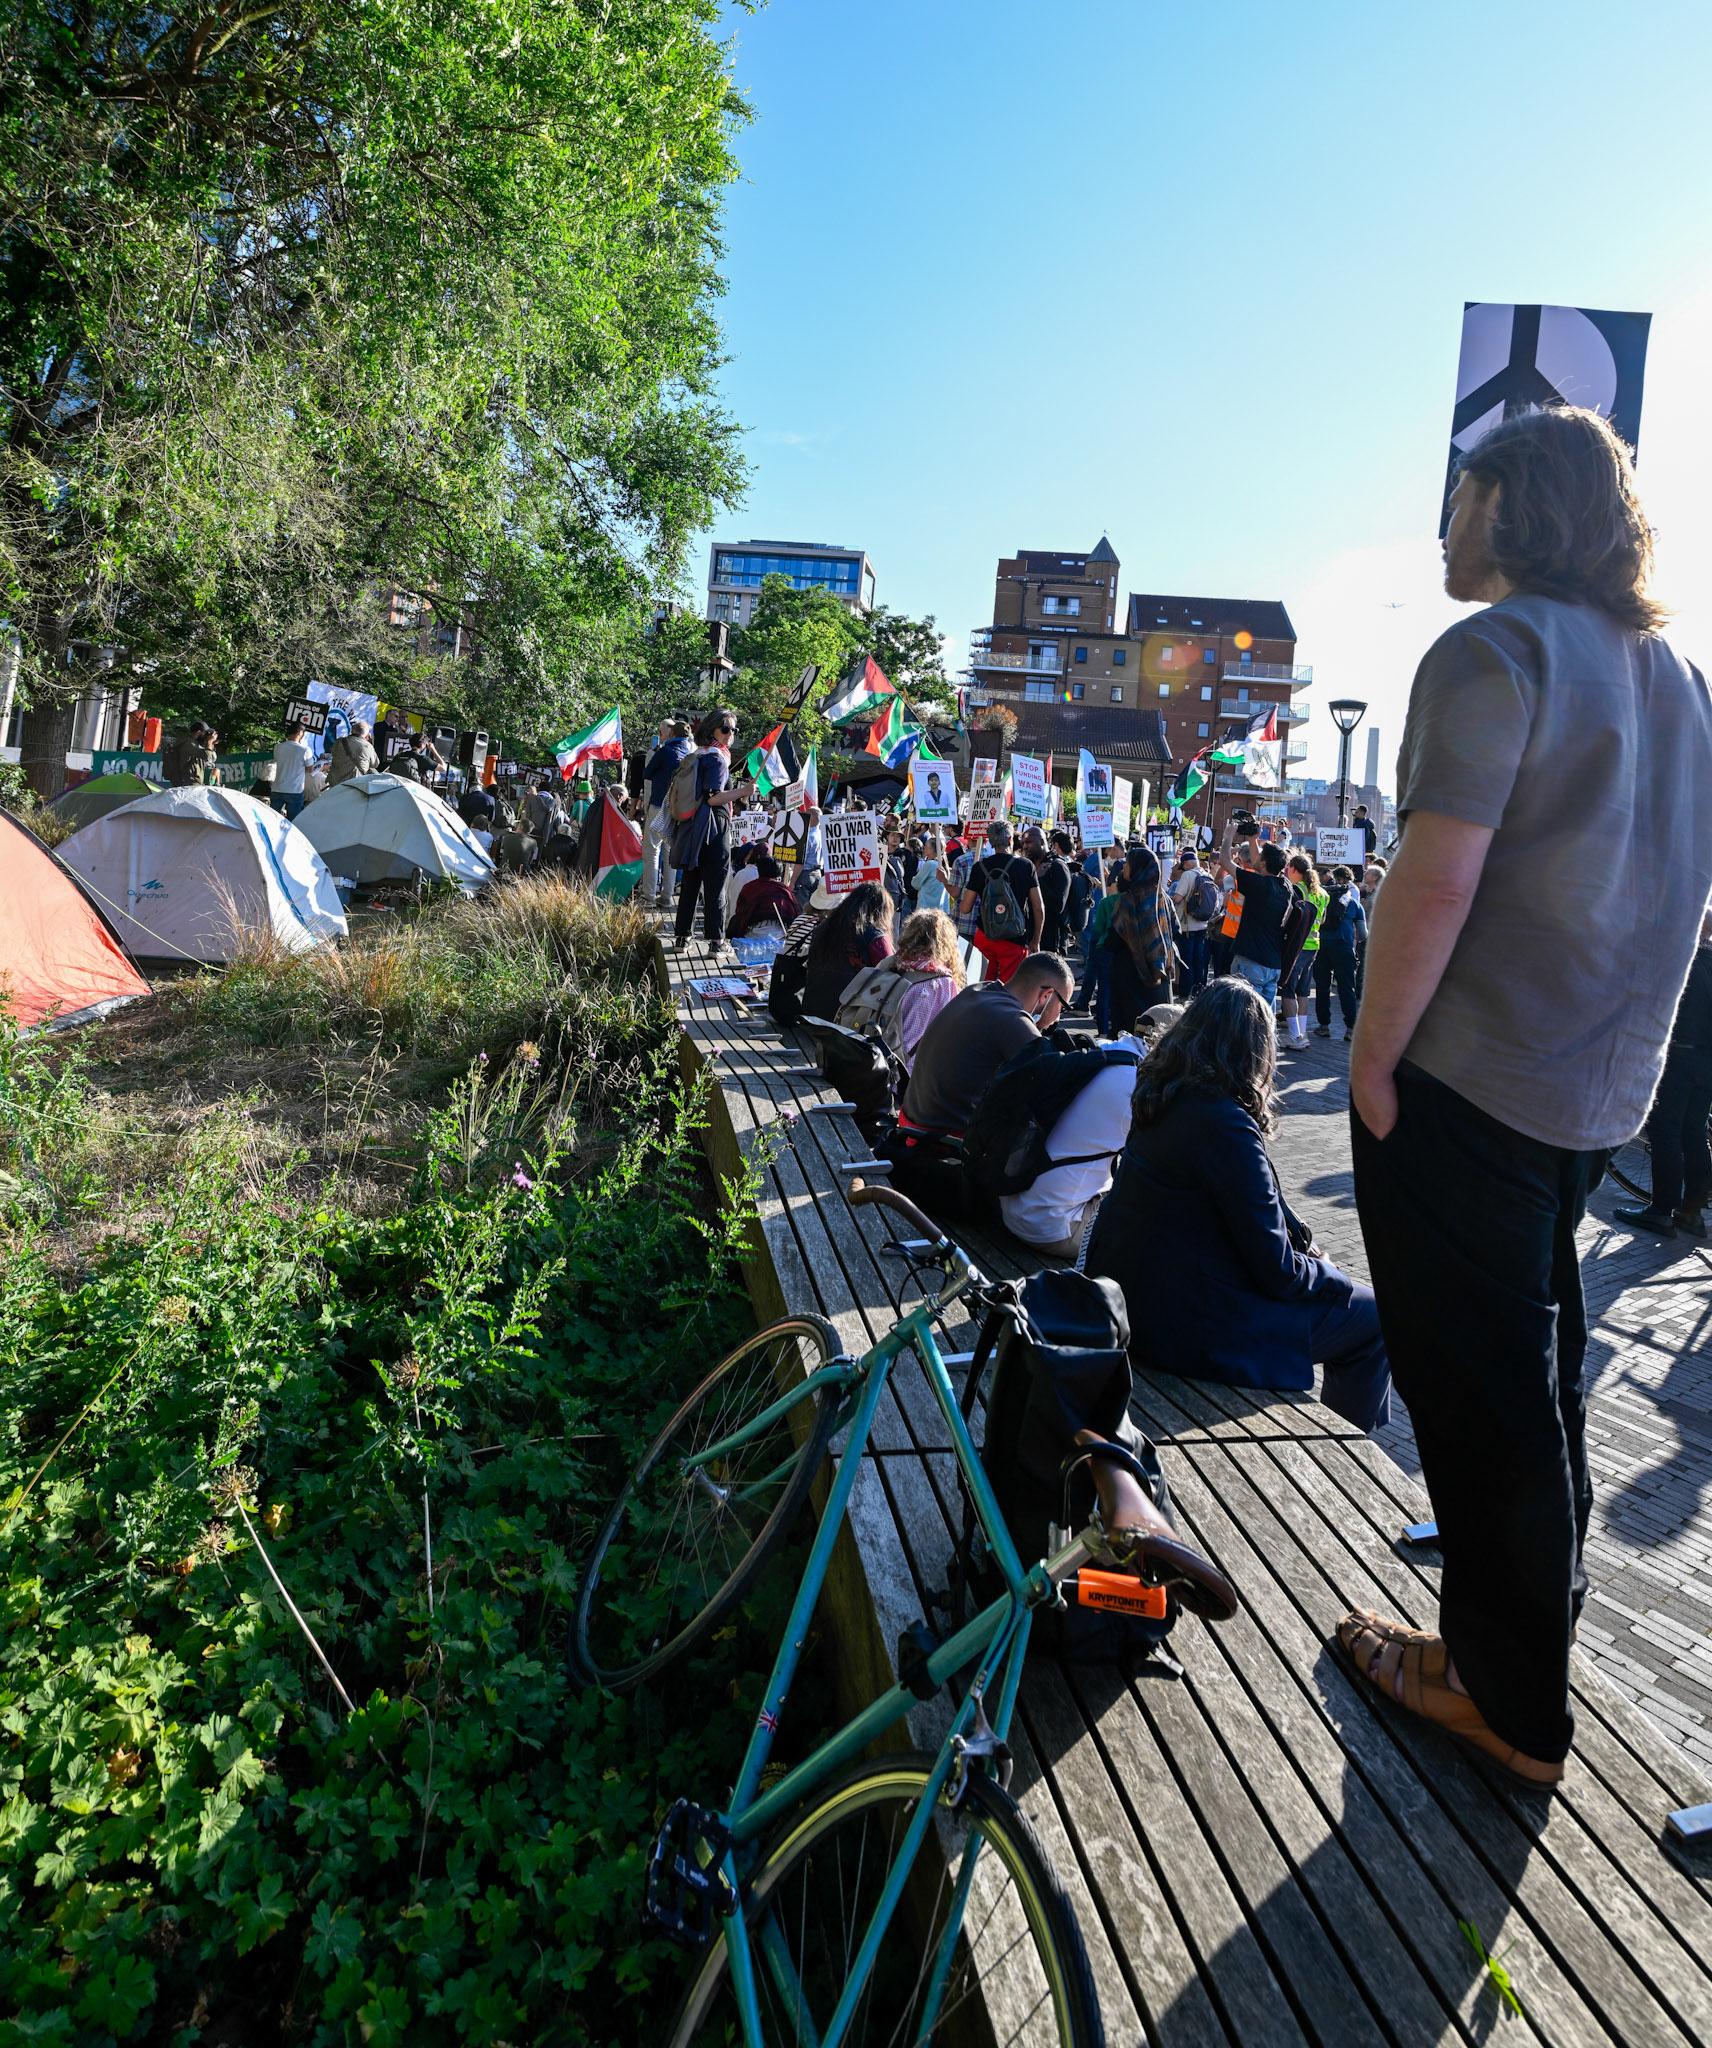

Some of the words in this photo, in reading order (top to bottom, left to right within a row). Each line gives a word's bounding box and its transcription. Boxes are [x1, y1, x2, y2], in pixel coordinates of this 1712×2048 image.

[295, 701, 312, 711] Hands
[332, 698, 350, 712] THE
[286, 701, 325, 729] Iran
[386, 737, 413, 757] Ira
[102, 759, 128, 776] NO
[215, 761, 247, 783] FREE
[1019, 761, 1039, 772] STOP
[1015, 769, 1042, 781] FUNDING
[1018, 778, 1043, 792] WARS
[974, 789, 985, 800] NO
[986, 788, 1003, 799] WAR
[973, 799, 991, 810] WITH
[971, 809, 988, 820] IRAN
[1086, 814, 1105, 823] STOP
[734, 820, 748, 830] WAR
[825, 822, 842, 839] NO
[845, 820, 872, 837] WAR
[1148, 831, 1174, 853] Iran
[1320, 831, 1348, 846] Community
[826, 837, 857, 854] WITH
[1320, 841, 1335, 850] Camp
[1320, 848, 1347, 858] Palestine
[828, 852, 856, 870] IRAN
[829, 872, 848, 882] Down
[848, 870, 863, 880] with
[830, 880, 860, 892] imperiali
[1088, 1592, 1146, 1608] KRYPTONITE
